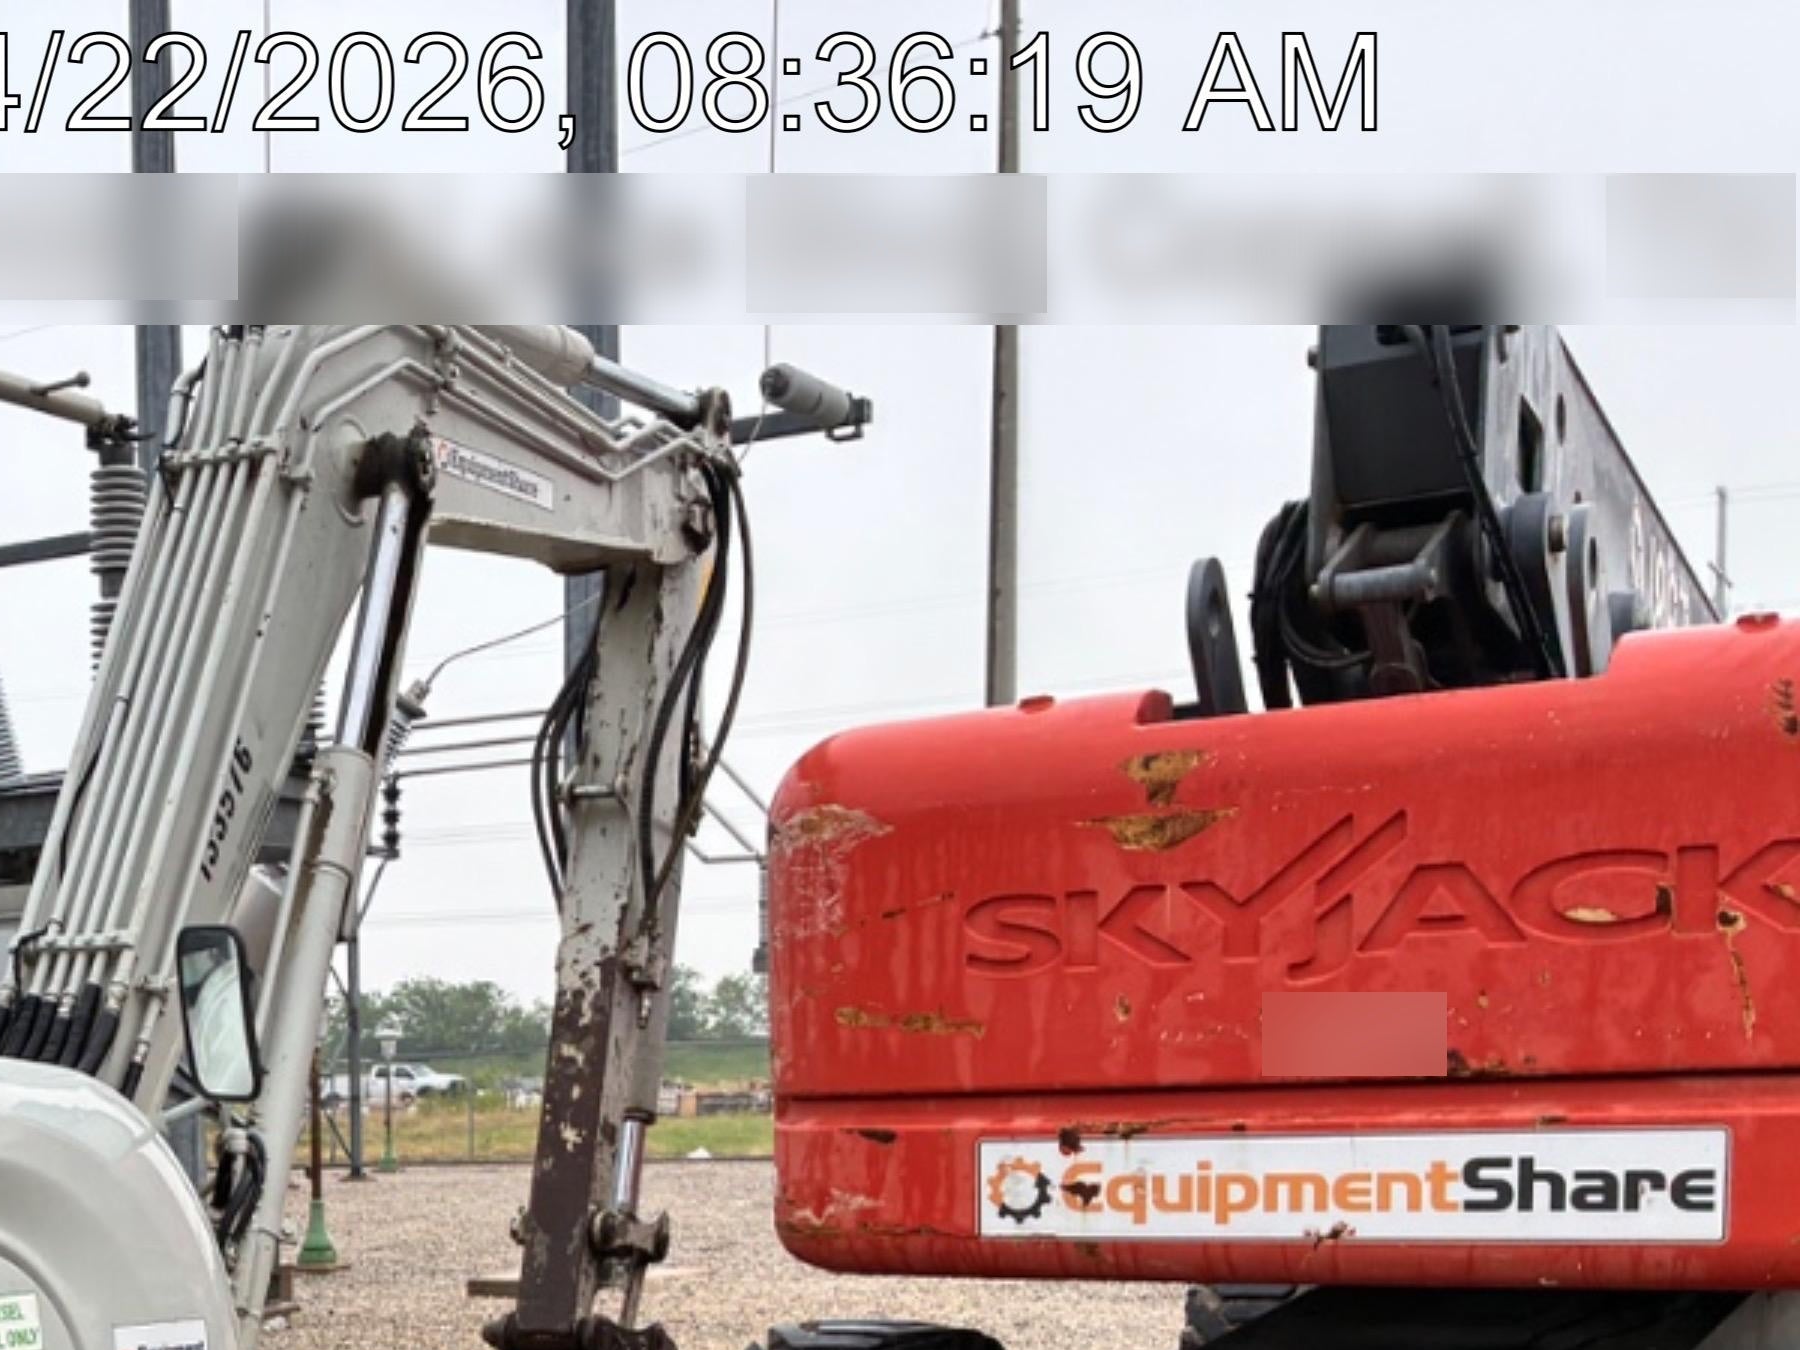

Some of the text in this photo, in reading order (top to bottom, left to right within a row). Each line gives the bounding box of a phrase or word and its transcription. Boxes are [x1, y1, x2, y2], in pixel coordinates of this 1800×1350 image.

[963, 808, 1800, 985] SKYJACK
[1061, 1156, 1716, 1224] EquipmentShare
[7, 1326, 38, 1348] ONLY
